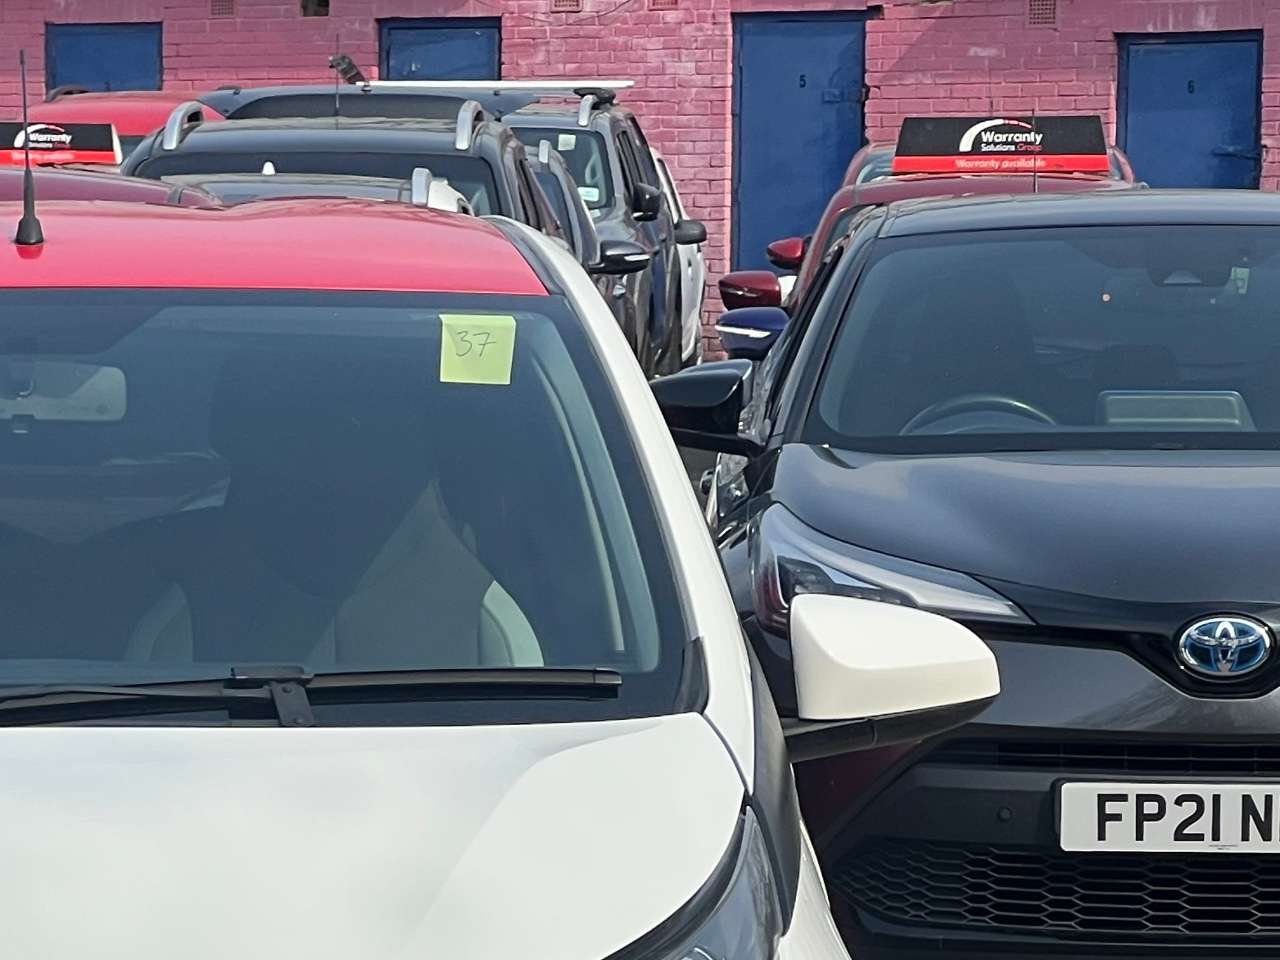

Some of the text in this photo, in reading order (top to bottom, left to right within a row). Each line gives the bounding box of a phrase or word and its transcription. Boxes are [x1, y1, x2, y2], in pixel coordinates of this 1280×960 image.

[799, 74, 807, 88] 5
[29, 133, 72, 144] Warranty
[981, 131, 1043, 145] Warranty
[981, 143, 1015, 151] Solutions
[955, 159, 1047, 169] Warranty available
[455, 331, 496, 357] 37
[1097, 793, 1280, 842] FP21 N
